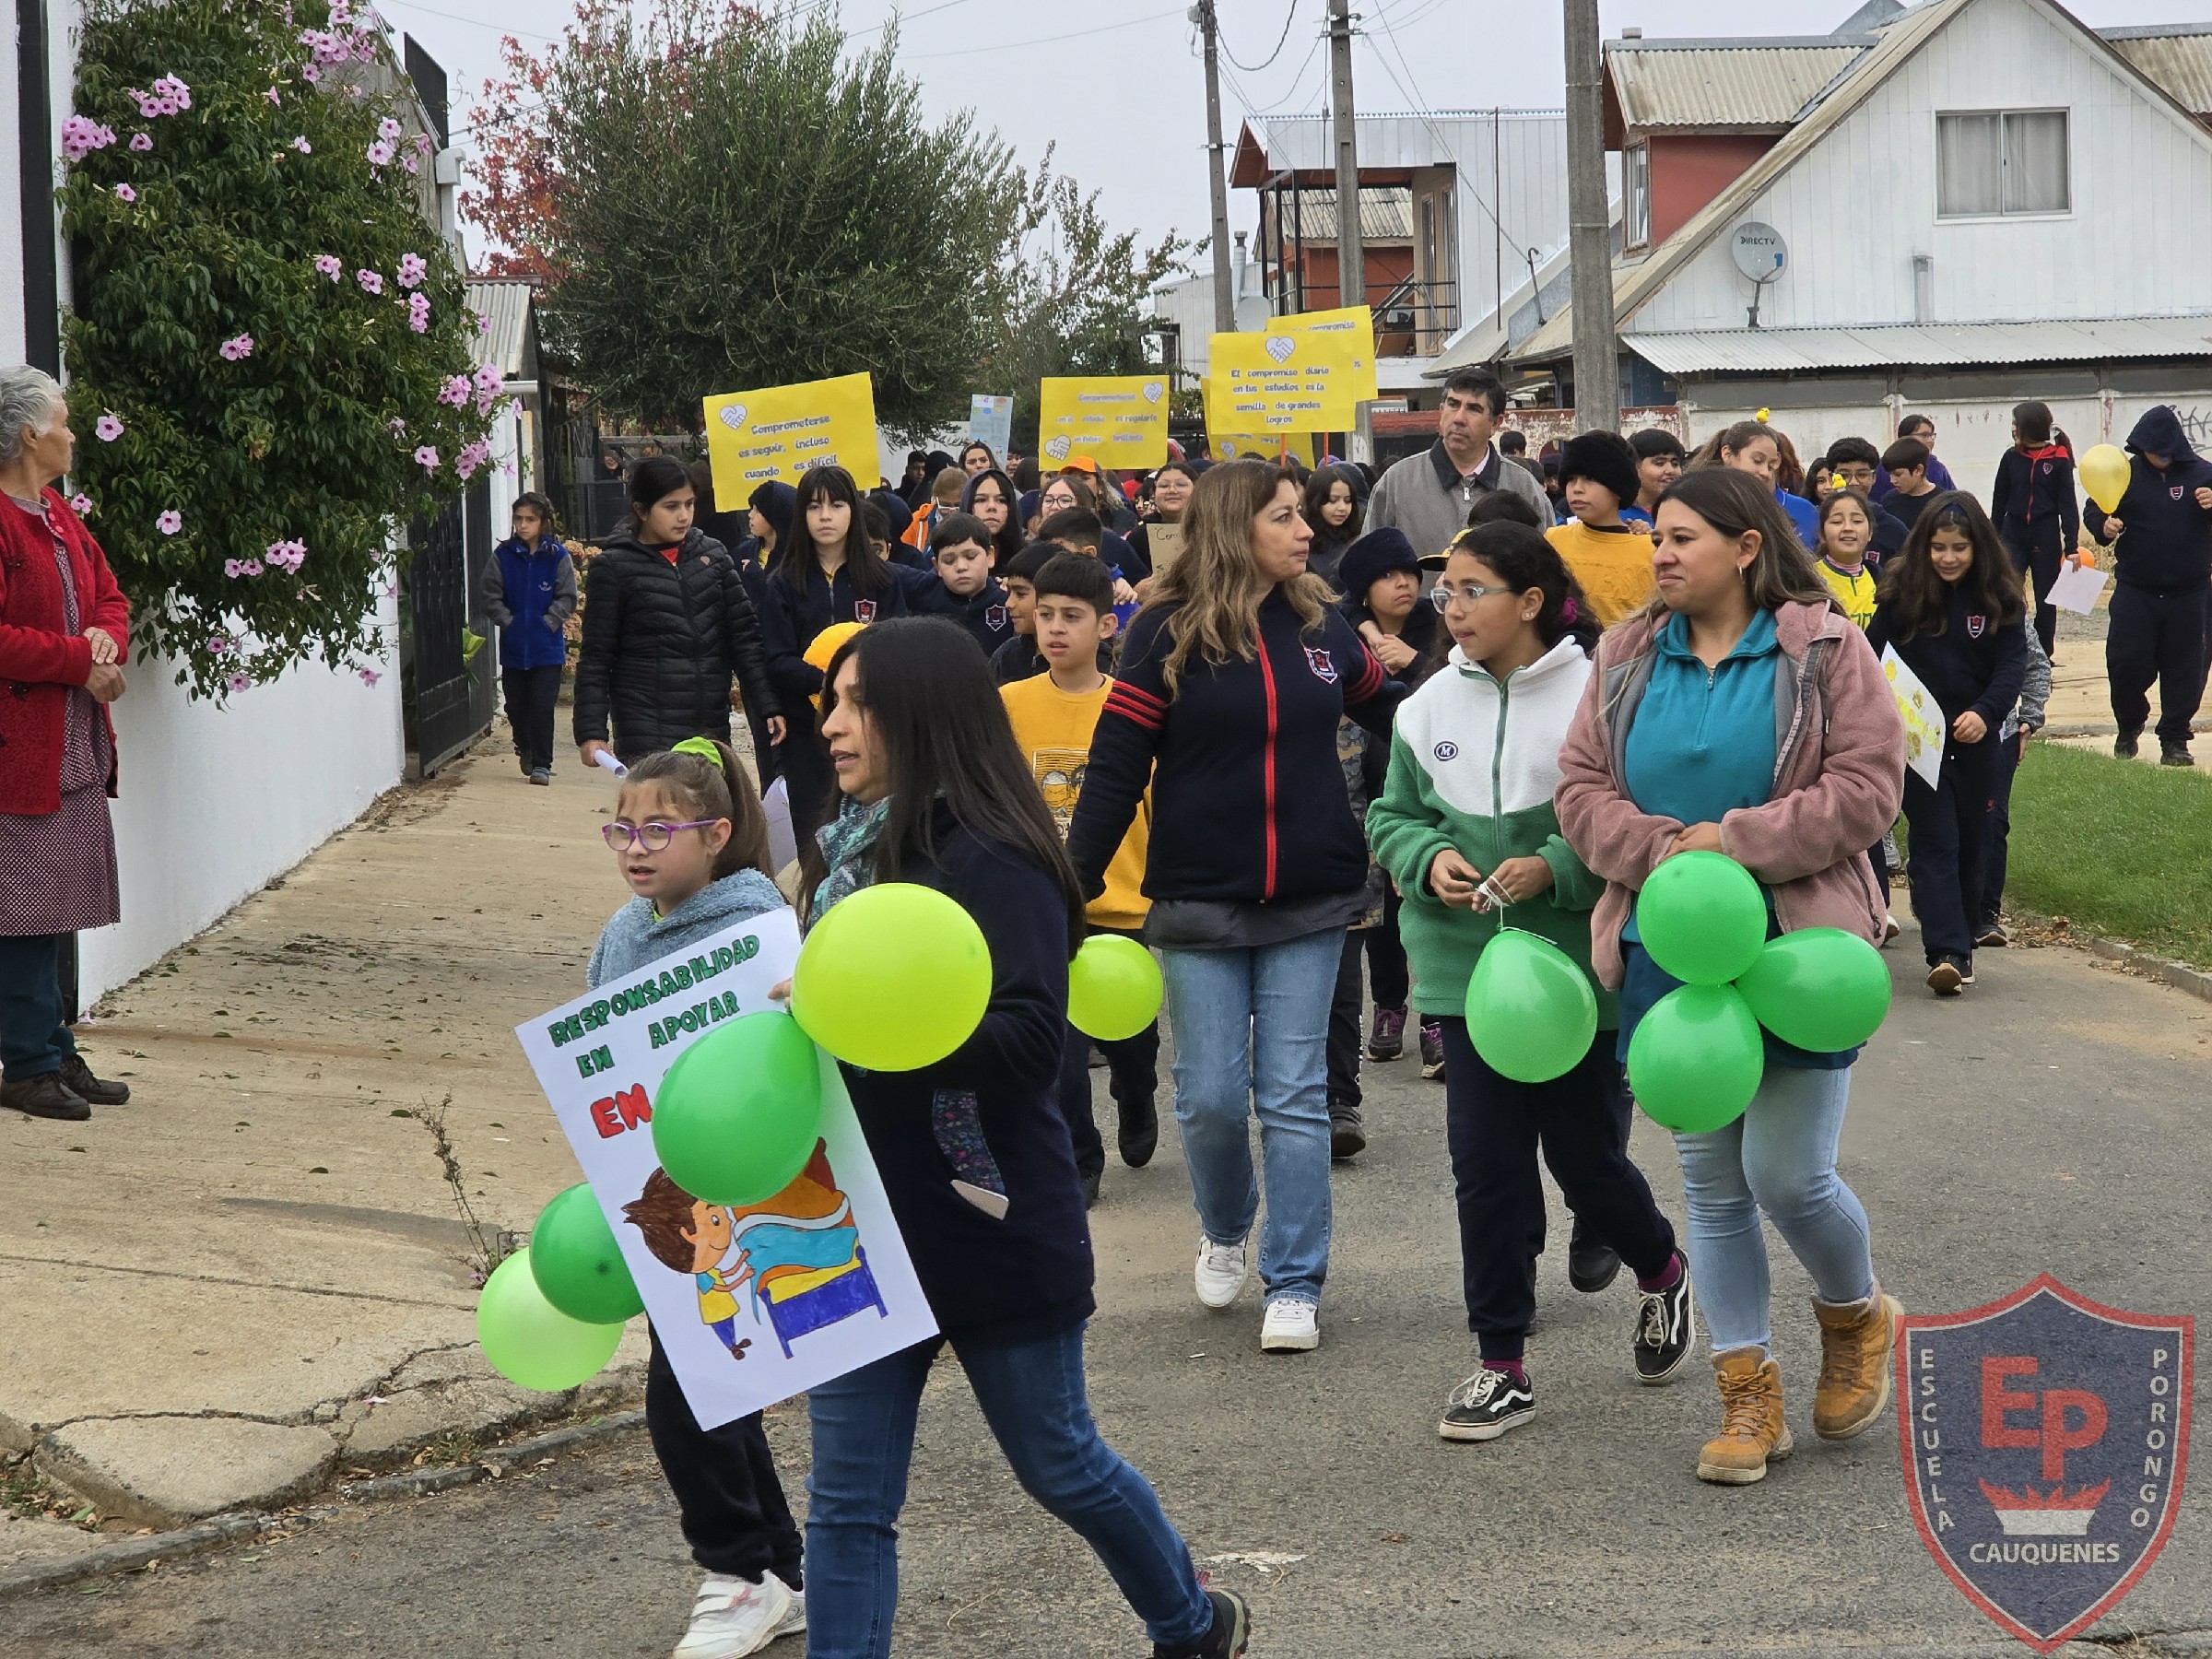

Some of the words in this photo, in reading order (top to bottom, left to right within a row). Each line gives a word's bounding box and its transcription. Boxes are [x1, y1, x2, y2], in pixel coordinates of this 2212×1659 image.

[1740, 236, 1776, 245] DIRECTV
[1230, 370, 1240, 378] El
[1247, 369, 1298, 378] compromiso
[1305, 367, 1329, 375] diario
[1245, 384, 1257, 393] tus
[1265, 382, 1299, 391] estudios
[1236, 402, 1266, 411] semilla
[1288, 400, 1321, 411] grandes
[751, 416, 830, 434] Comprometerse
[752, 443, 786, 456] seguir,
[795, 437, 830, 449] incluso
[745, 466, 780, 479] cuando
[794, 462, 805, 470] es
[547, 935, 759, 1047] RESPONSABILIDAD
[576, 1044, 615, 1079] EN
[648, 990, 740, 1049] APOYAR
[590, 1083, 653, 1139] EN
